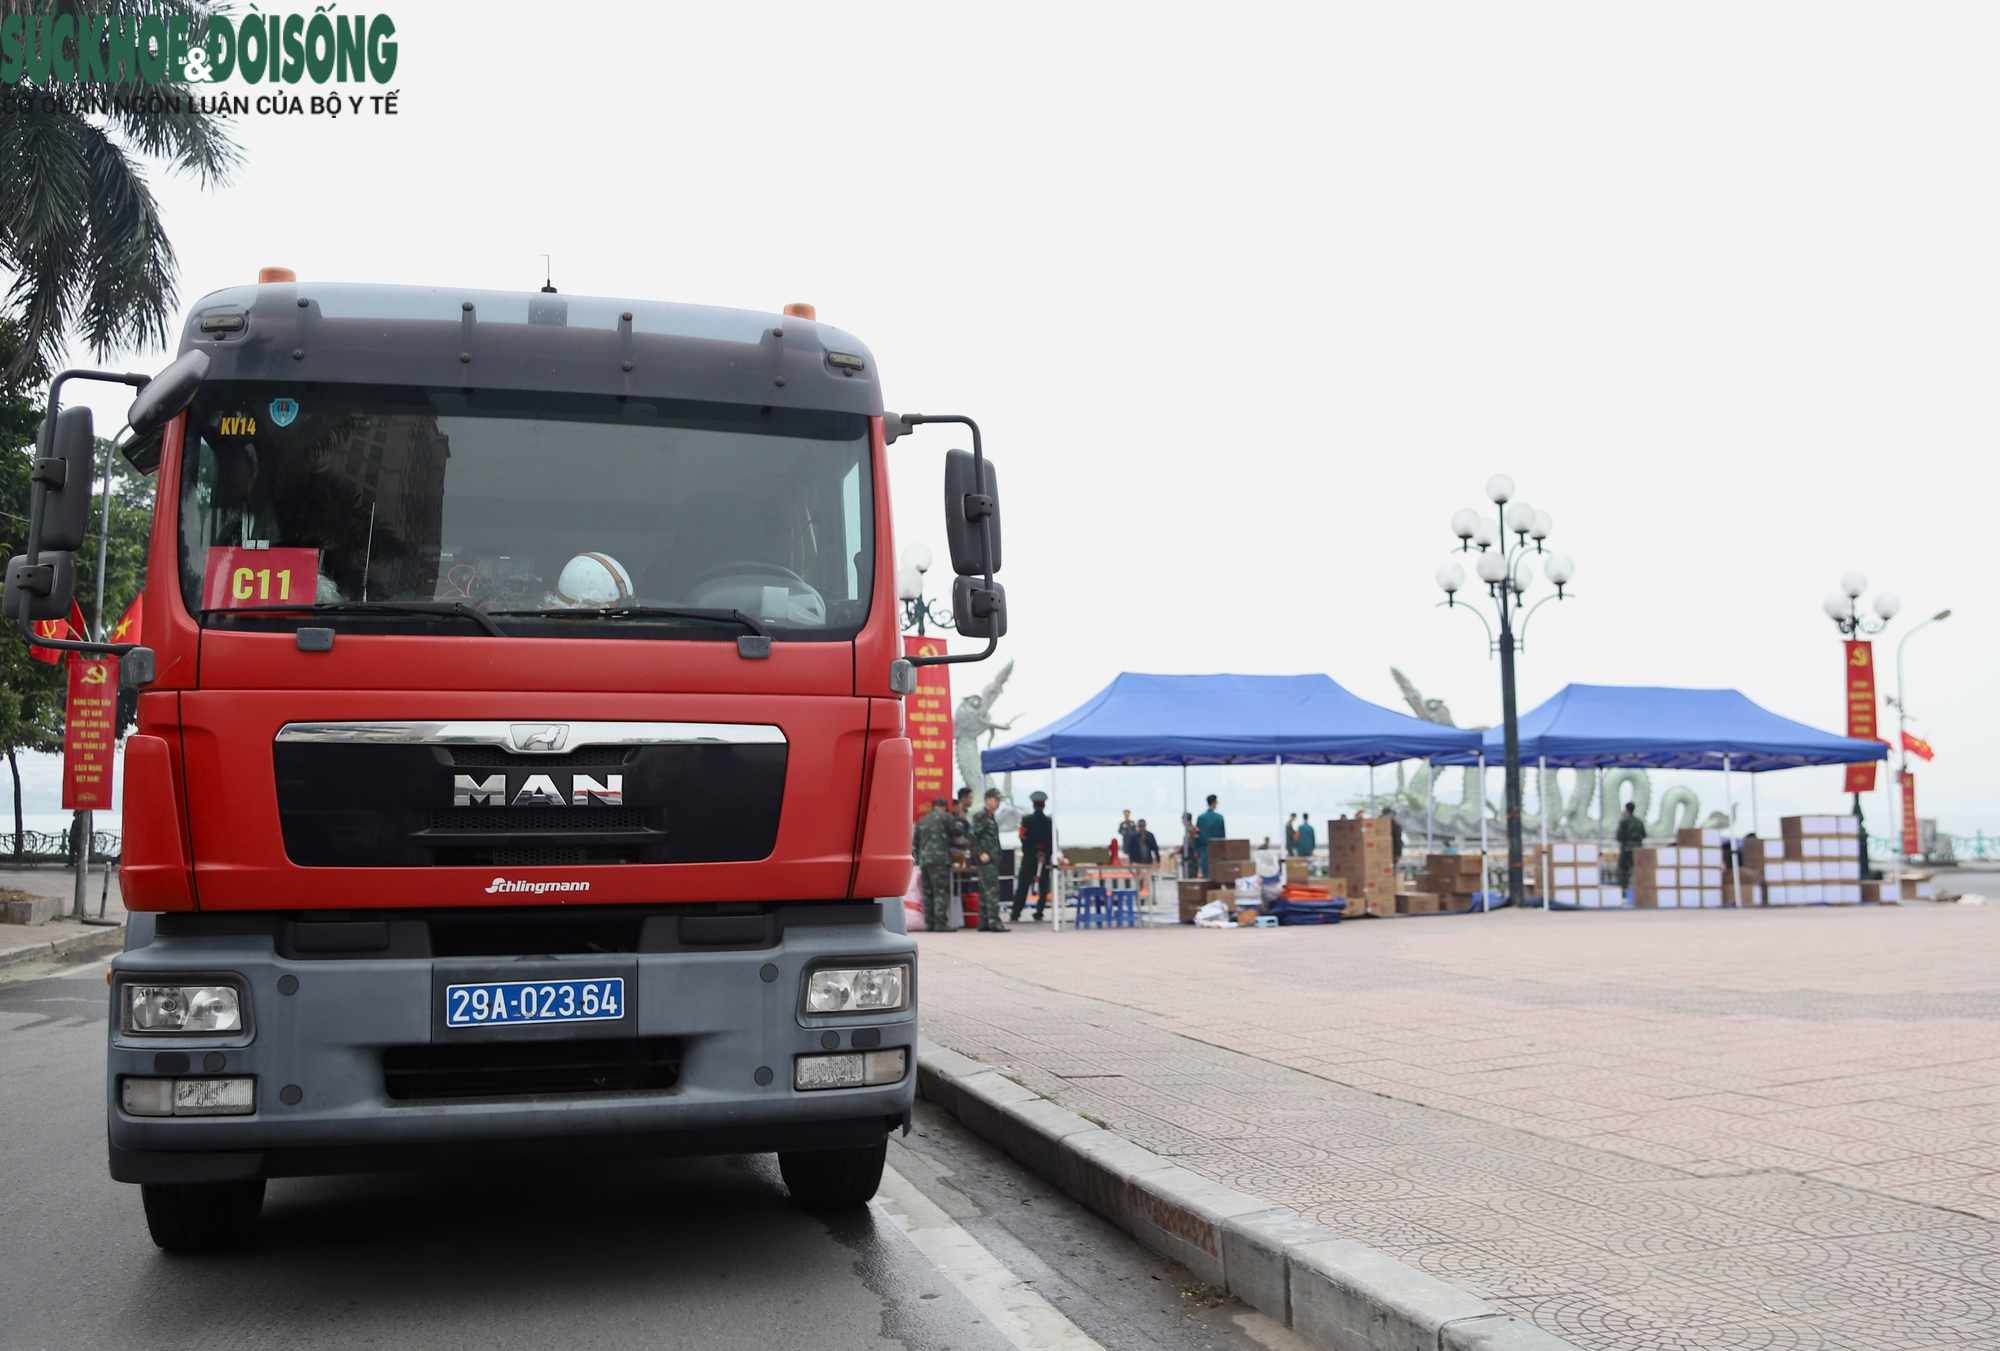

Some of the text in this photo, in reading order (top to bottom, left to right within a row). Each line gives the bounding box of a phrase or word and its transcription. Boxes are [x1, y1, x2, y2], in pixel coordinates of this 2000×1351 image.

[221, 417, 256, 436] KV14
[232, 567, 291, 600] C11
[454, 774, 623, 806] MAN
[485, 877, 590, 894] Schlingmann
[452, 983, 618, 1022] 29A-023.64
